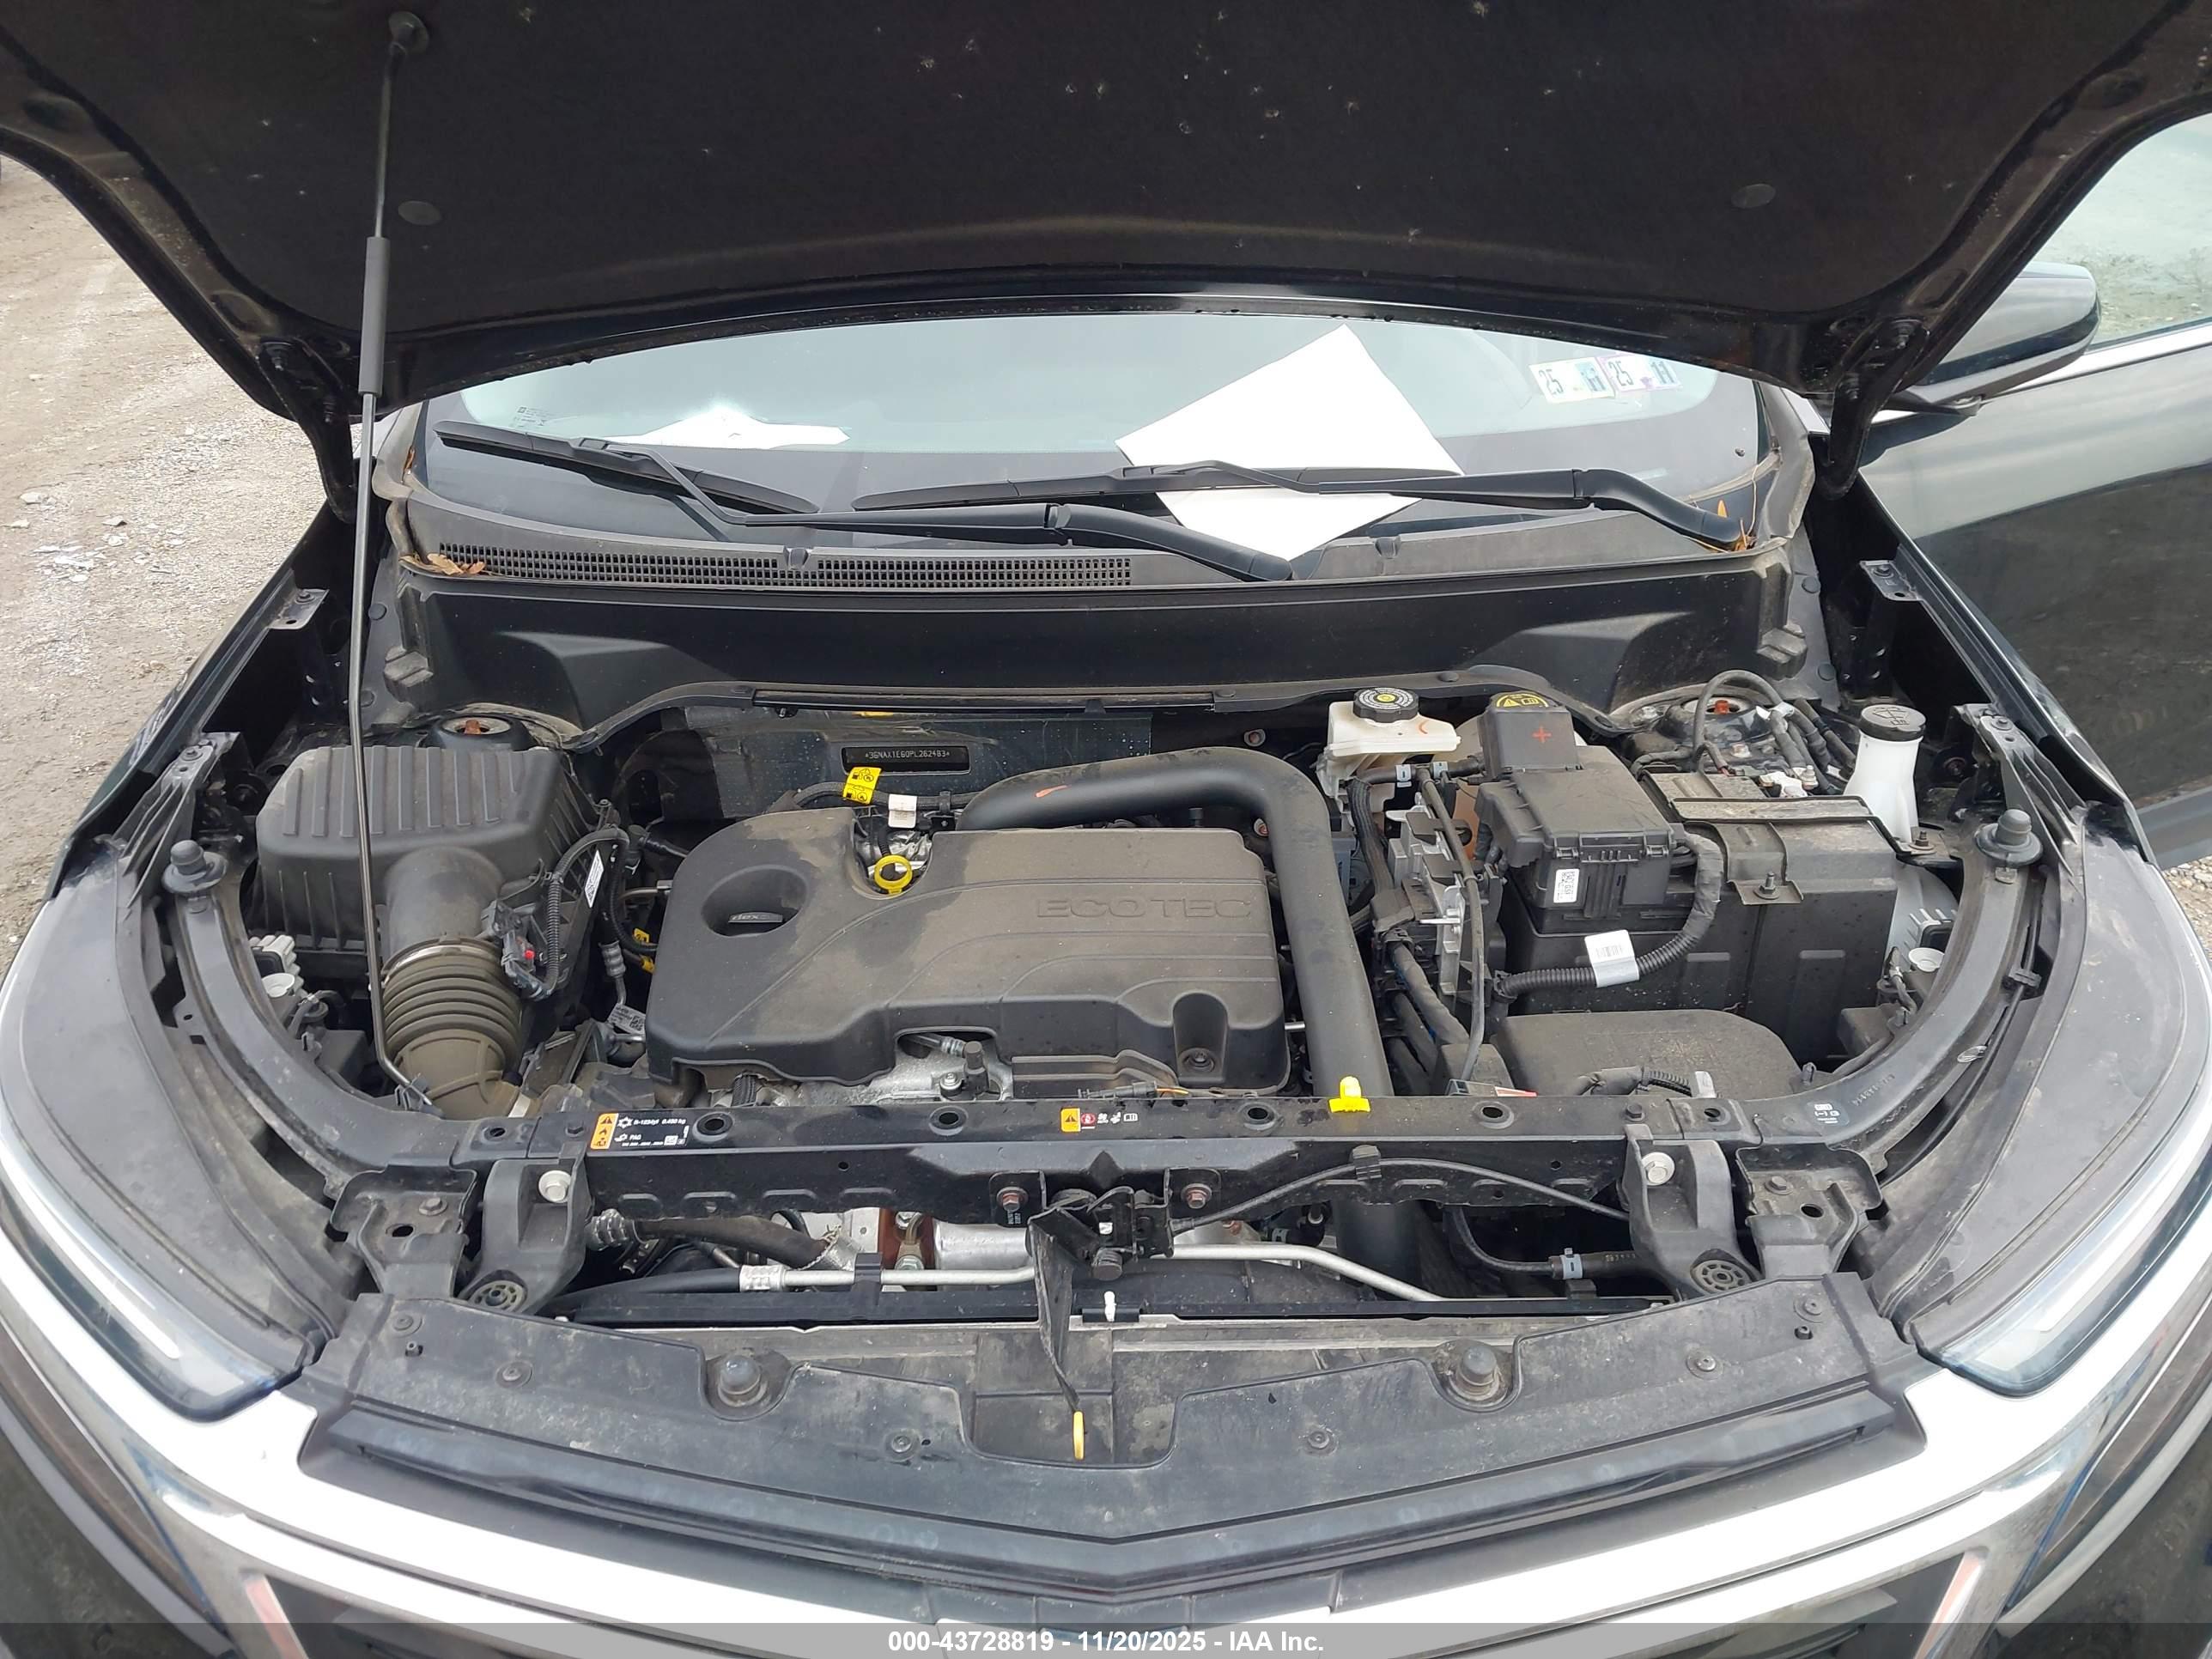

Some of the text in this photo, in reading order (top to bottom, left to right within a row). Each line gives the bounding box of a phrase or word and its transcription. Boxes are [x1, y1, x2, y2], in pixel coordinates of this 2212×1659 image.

[1538, 368, 1564, 395] 25
[1608, 361, 1674, 386] 25 11
[1036, 896, 1251, 918] ECOTEC
